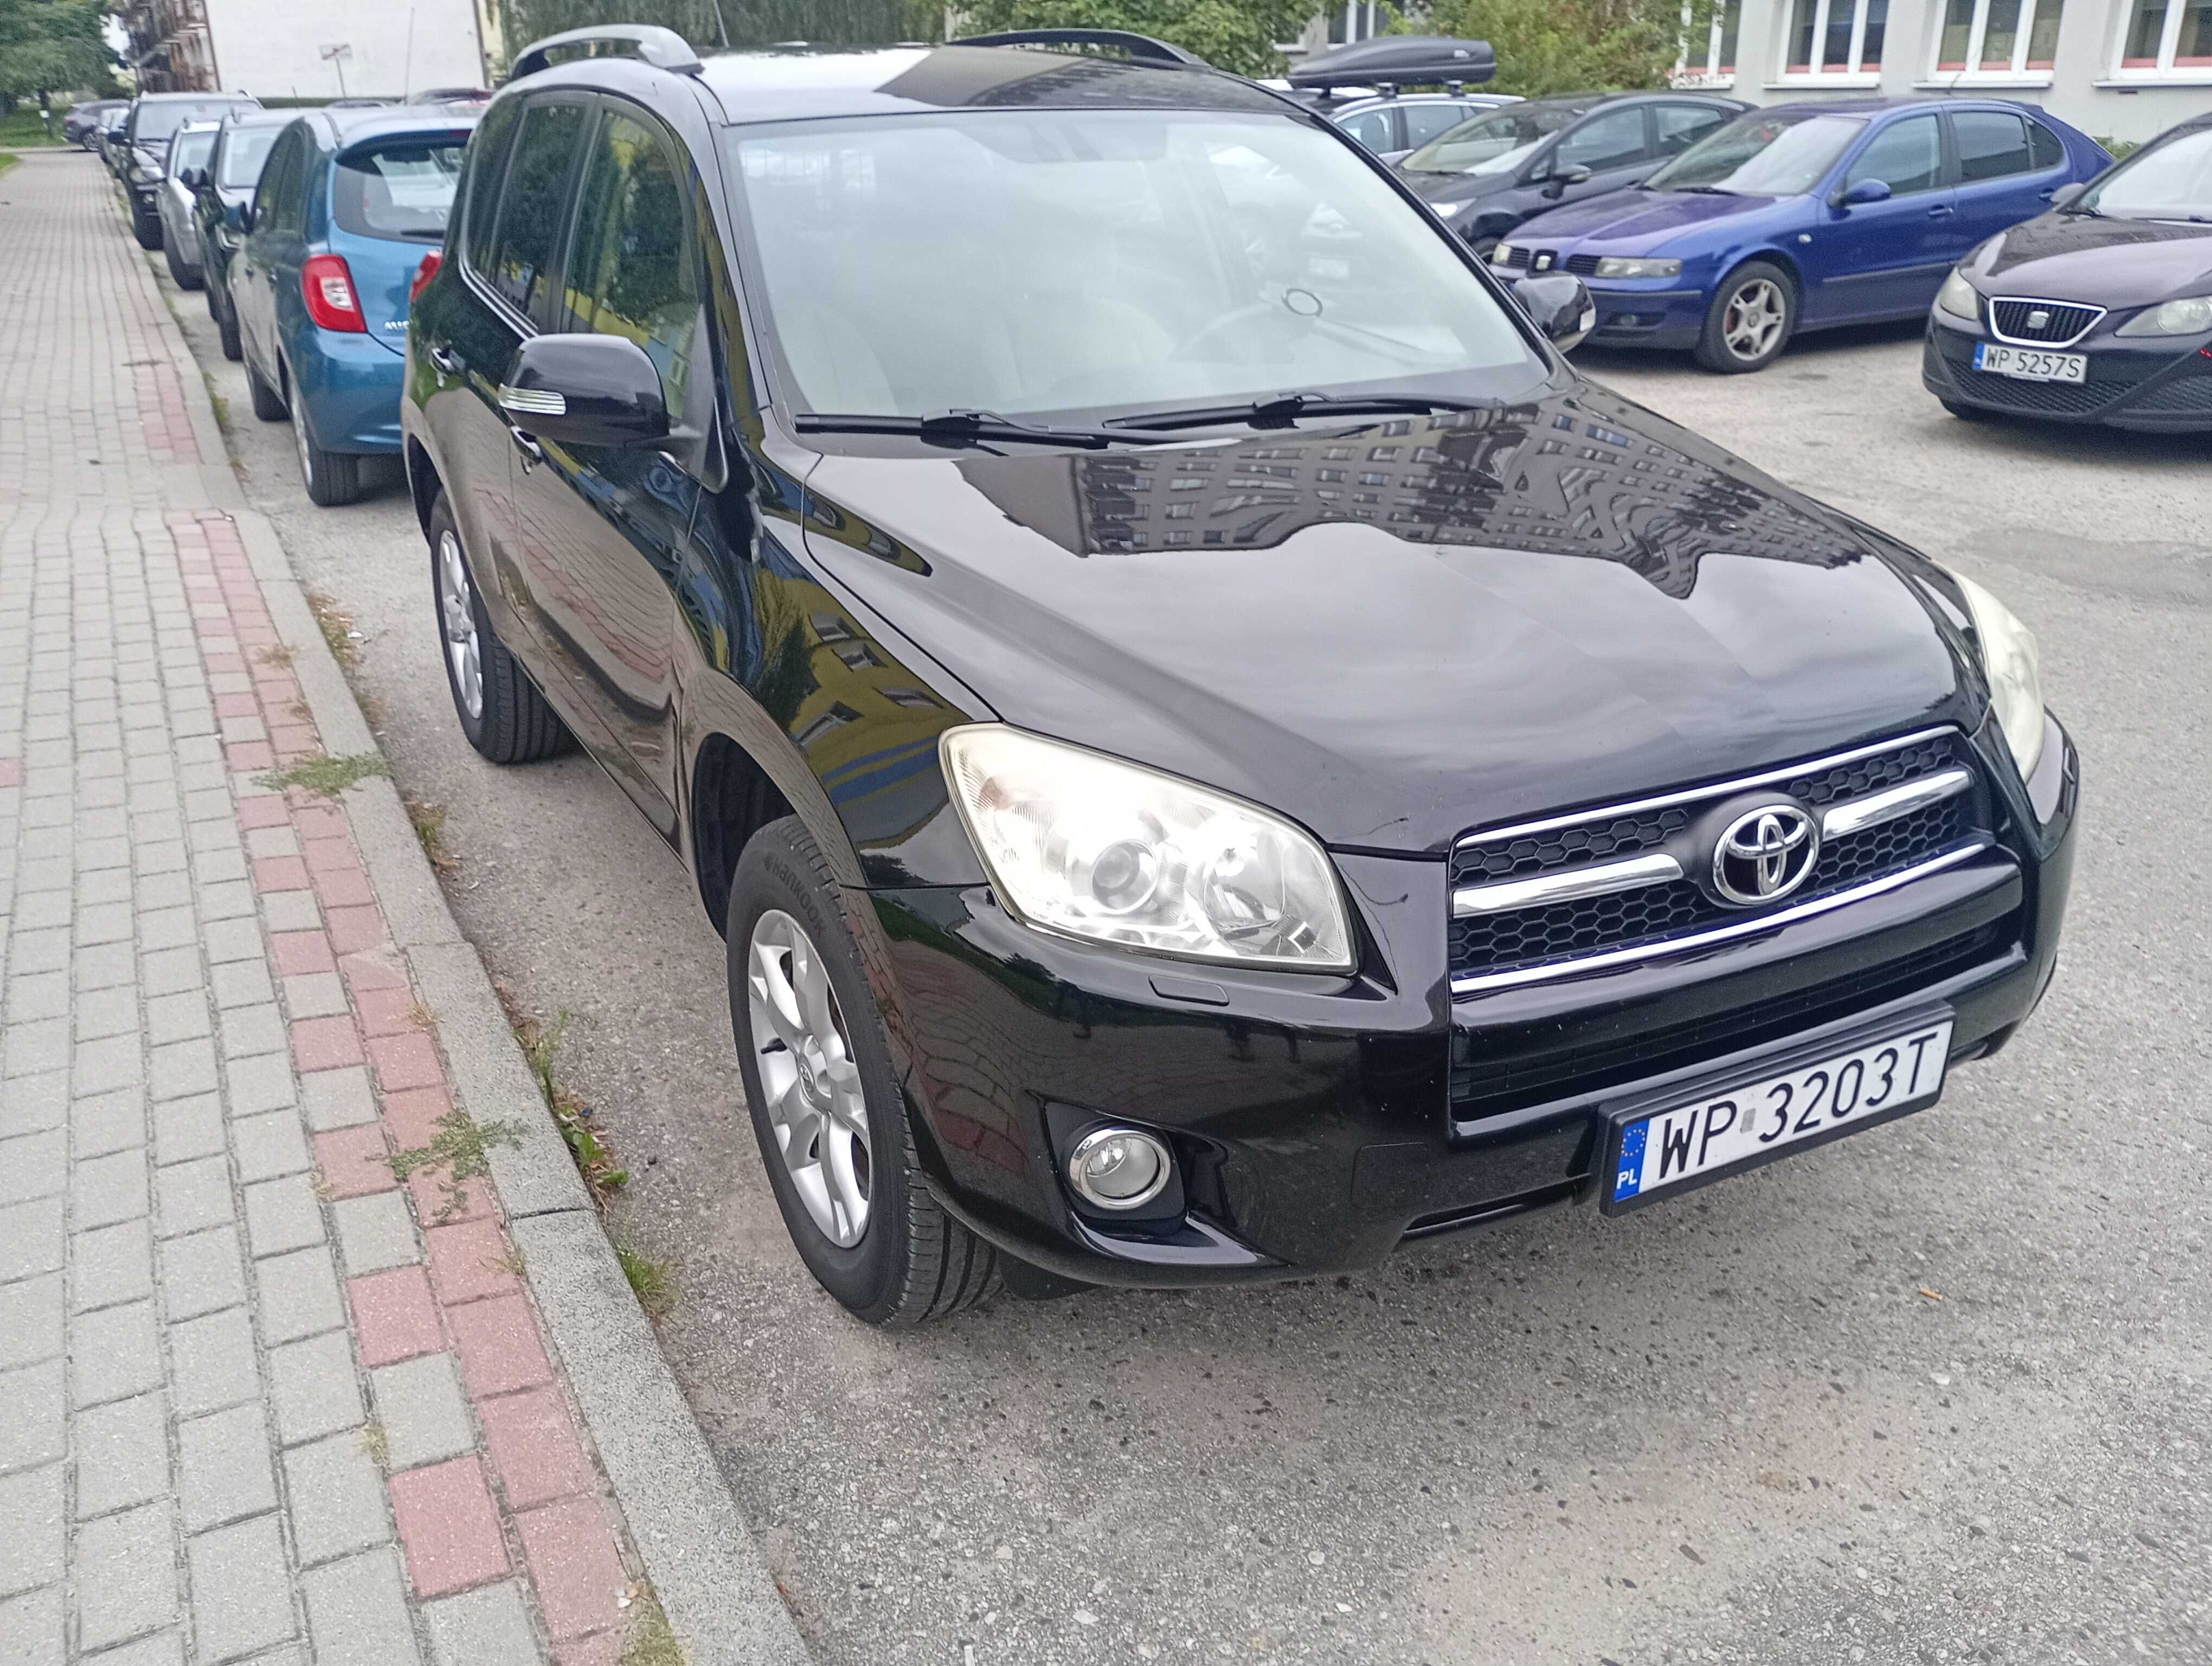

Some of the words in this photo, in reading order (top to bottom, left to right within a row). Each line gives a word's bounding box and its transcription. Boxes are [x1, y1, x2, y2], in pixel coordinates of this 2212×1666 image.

[1986, 348, 2010, 368] WP
[2016, 352, 2081, 379] 5257S
[1659, 1100, 1737, 1179] WP
[1758, 1032, 1938, 1143] 3203T
[1617, 1168, 1637, 1189] PL
